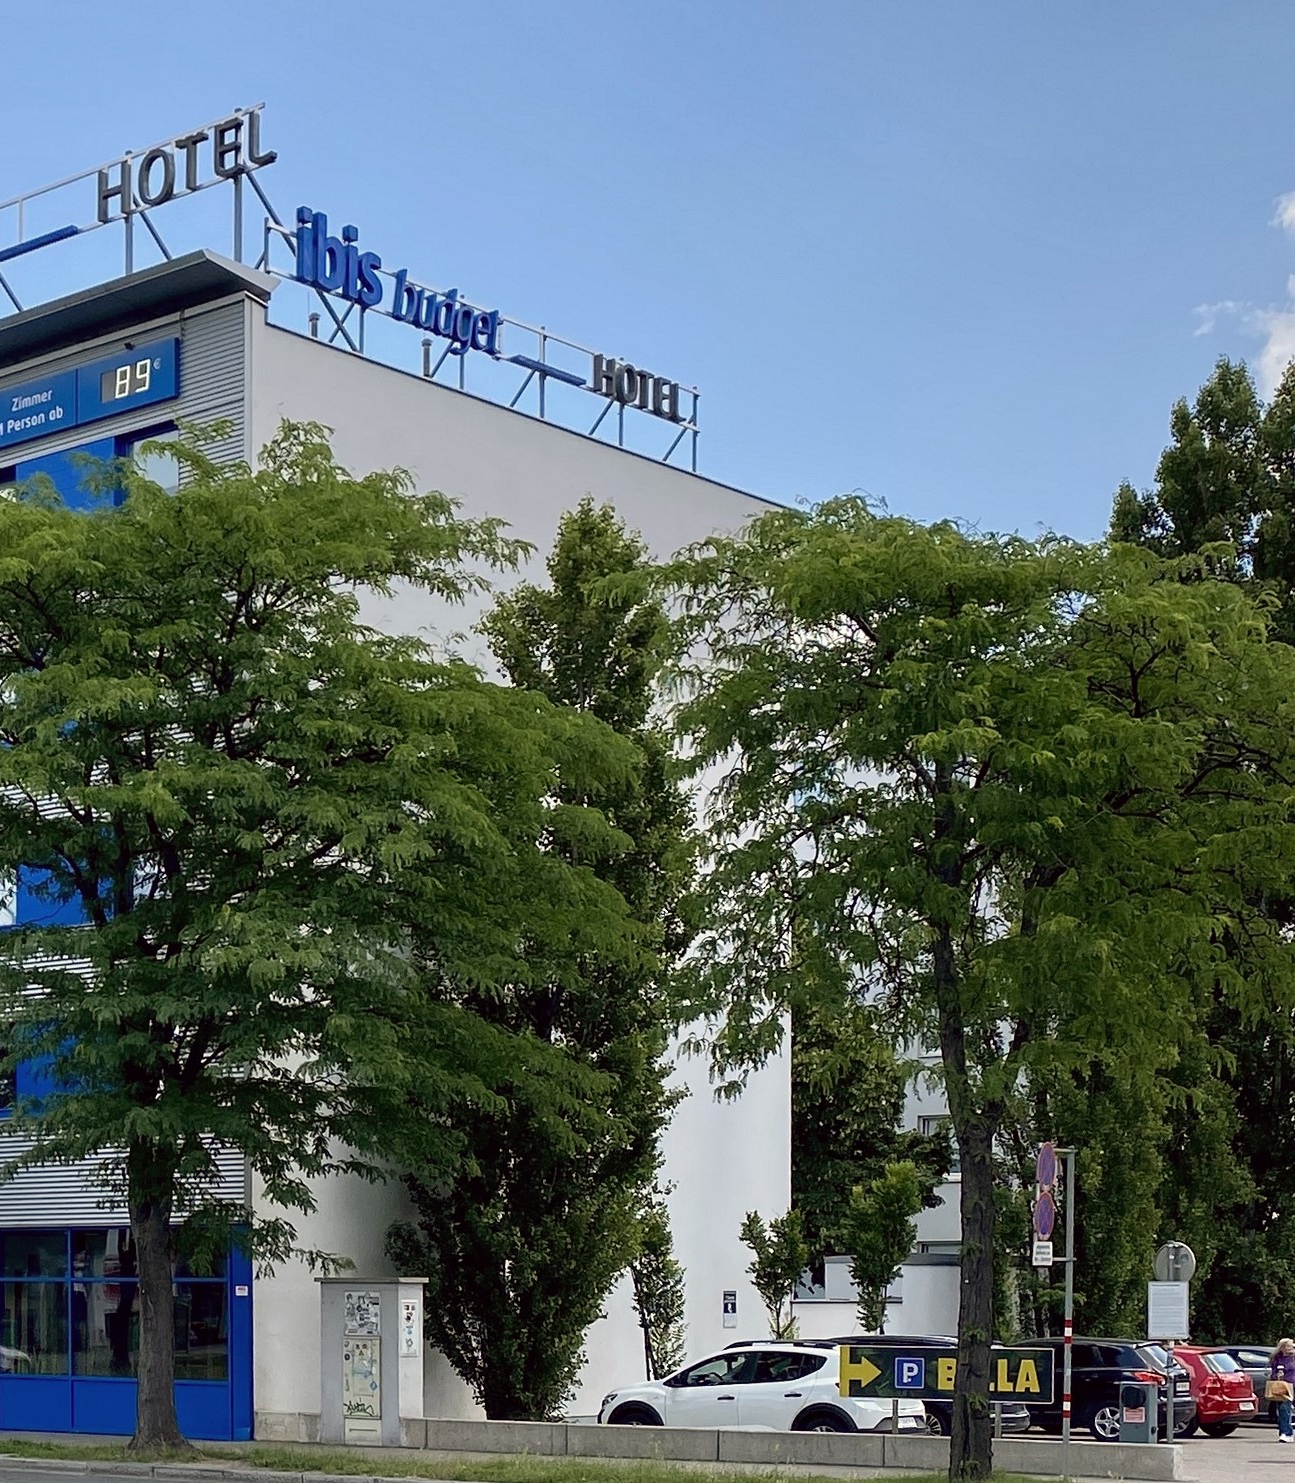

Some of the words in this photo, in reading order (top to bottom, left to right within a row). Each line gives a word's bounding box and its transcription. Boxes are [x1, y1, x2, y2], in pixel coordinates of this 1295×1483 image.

[98, 110, 278, 223] HOTEL
[296, 206, 383, 307] ibis
[392, 268, 501, 355] budget
[593, 353, 686, 423] HOTEL
[115, 359, 151, 399] 89
[7, 413, 46, 434] Person
[48, 405, 64, 422] ab
[11, 389, 54, 412] Zimmer
[938, 1357, 1041, 1393] BLA
